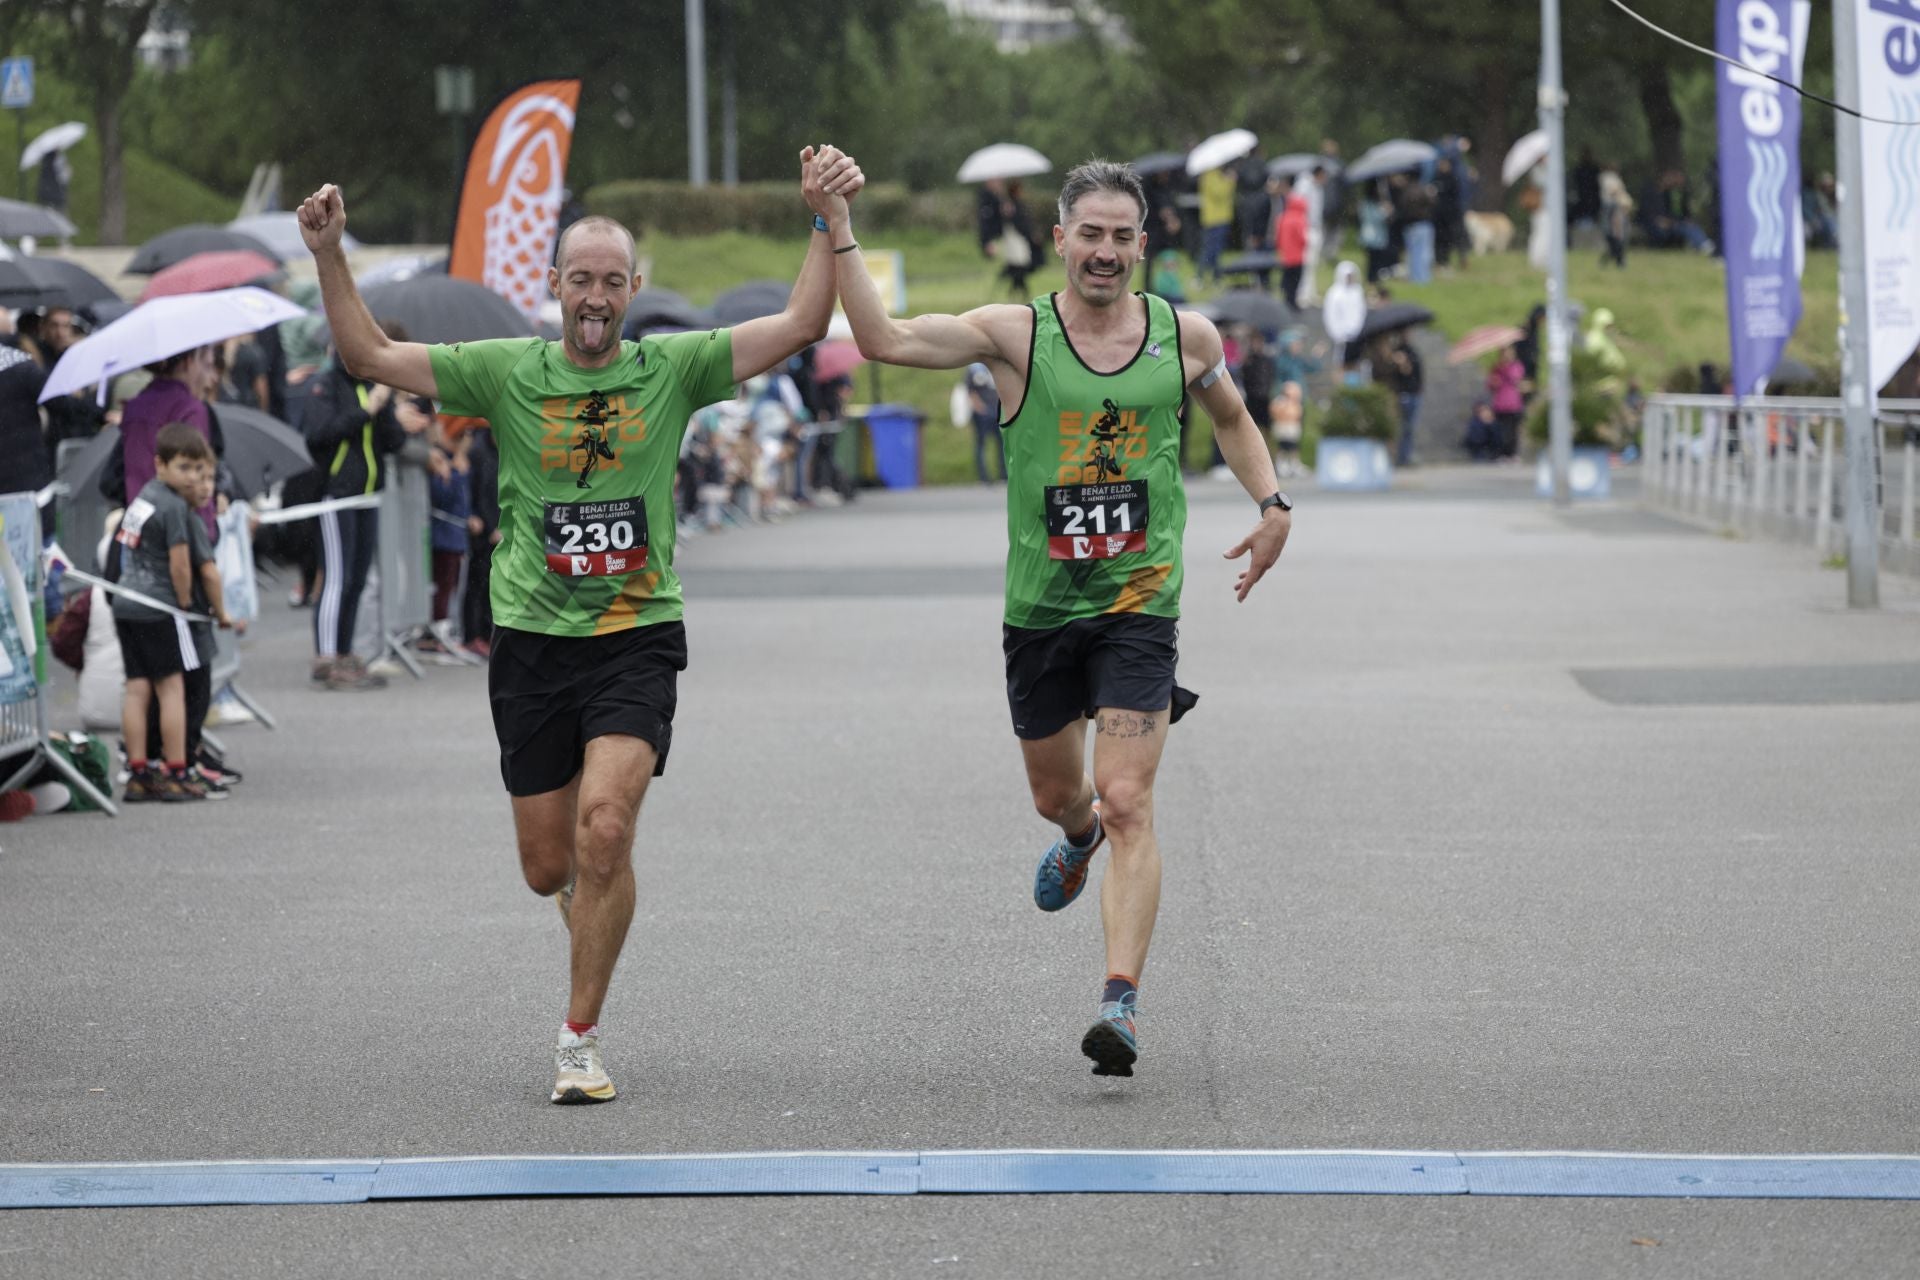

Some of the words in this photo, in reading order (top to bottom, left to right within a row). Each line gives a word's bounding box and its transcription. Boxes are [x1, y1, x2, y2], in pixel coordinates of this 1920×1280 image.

[1727, 0, 1788, 136] ekp
[1082, 485, 1109, 496] BEÑAT
[1111, 484, 1132, 494] ELZO
[580, 503, 608, 514] BEÑAT
[610, 502, 630, 511] ELZO
[1062, 502, 1131, 535] 211
[560, 520, 634, 554] 230
